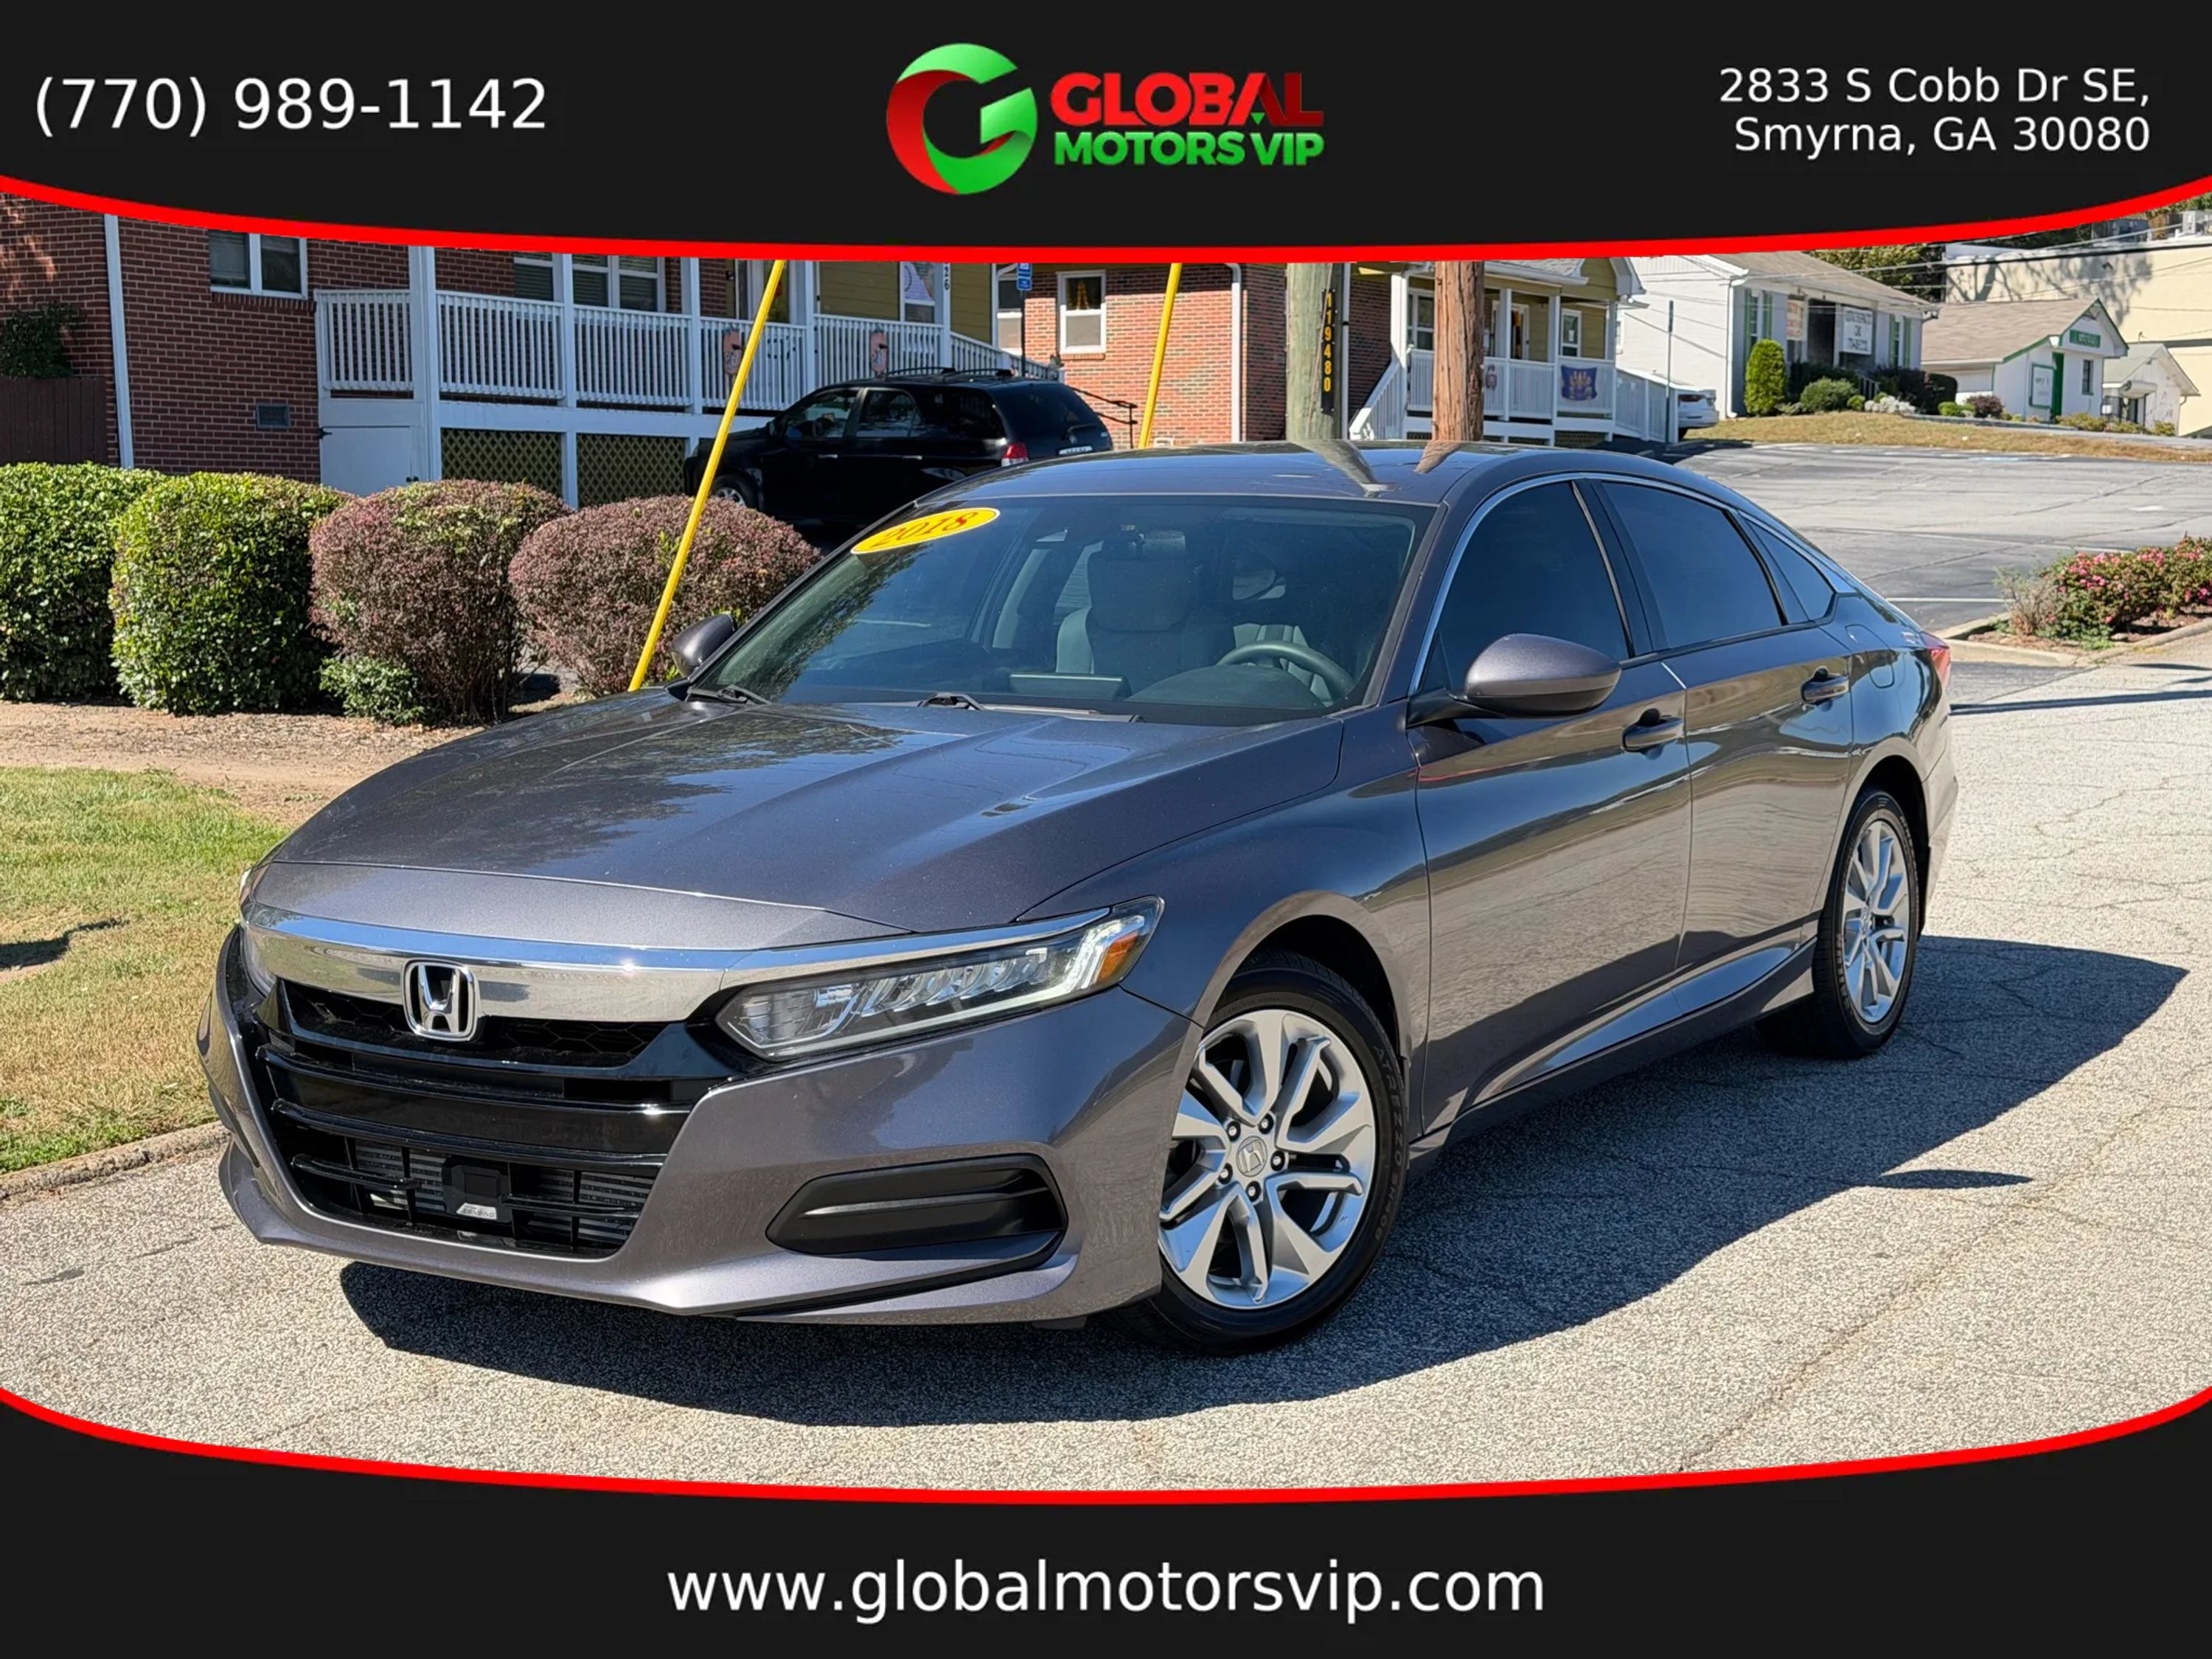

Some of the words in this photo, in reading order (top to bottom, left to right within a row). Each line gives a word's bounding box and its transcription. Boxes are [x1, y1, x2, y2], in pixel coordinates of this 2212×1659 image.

[1324, 293, 1332, 392] 119480
[870, 512, 979, 548] 2018
[1374, 1046, 1403, 1166] ATREZZO
